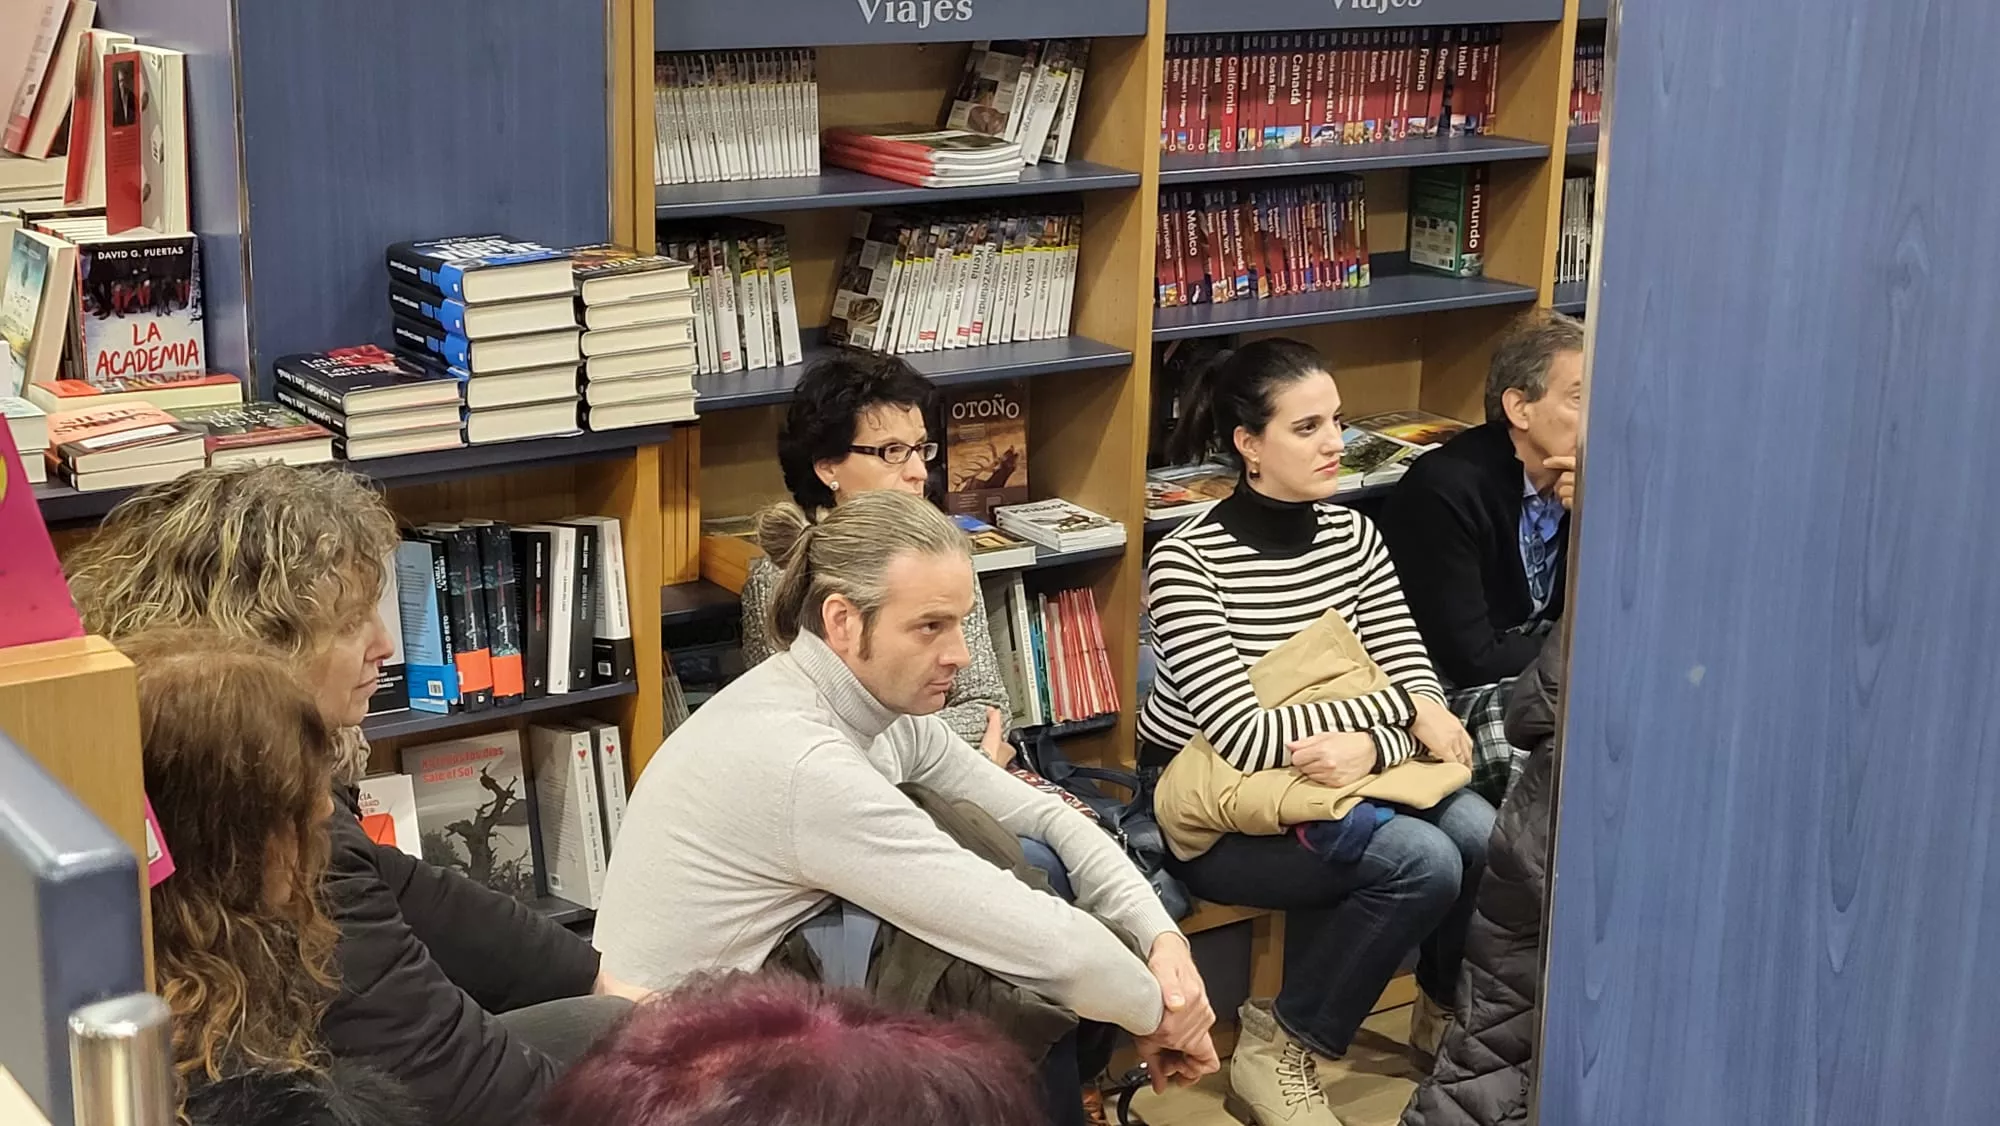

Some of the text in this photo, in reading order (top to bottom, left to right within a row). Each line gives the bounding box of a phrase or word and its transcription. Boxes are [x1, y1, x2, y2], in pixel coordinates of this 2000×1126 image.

[858, 0, 973, 28] Viajes
[1214, 57, 1222, 83] Brasil
[1268, 56, 1276, 105] Costa Rica
[1290, 55, 1303, 105] Canadá
[1317, 54, 1325, 81] Corea
[1417, 48, 1429, 91] Francia
[1436, 48, 1448, 80] Grecia
[1457, 46, 1468, 76] Italia
[1066, 80, 1080, 120] PORTUGAL
[1226, 57, 1237, 114] California
[1162, 214, 1172, 259] Marruecos
[1186, 209, 1198, 256] México
[1233, 209, 1244, 270] Nueva Zelanda
[1469, 194, 1481, 248] mundo
[98, 246, 184, 260] DAVID G. PUERTAS
[971, 250, 985, 280] Kenia
[780, 280, 788, 304] ITALIA
[954, 262, 967, 311] NUEVA YORK
[977, 245, 996, 315] Nueva Zelanda
[998, 262, 1009, 302] TAILANDIA
[1009, 260, 1020, 306] MARRUECOS
[1023, 258, 1036, 299] ESPAÑA
[747, 282, 755, 318] FRANCIA
[132, 322, 162, 346] LA
[96, 338, 199, 376] ACADEMIA
[952, 393, 1019, 419] OTOÑO
[434, 560, 443, 589] CAMILLA
[459, 767, 474, 778] Sol
